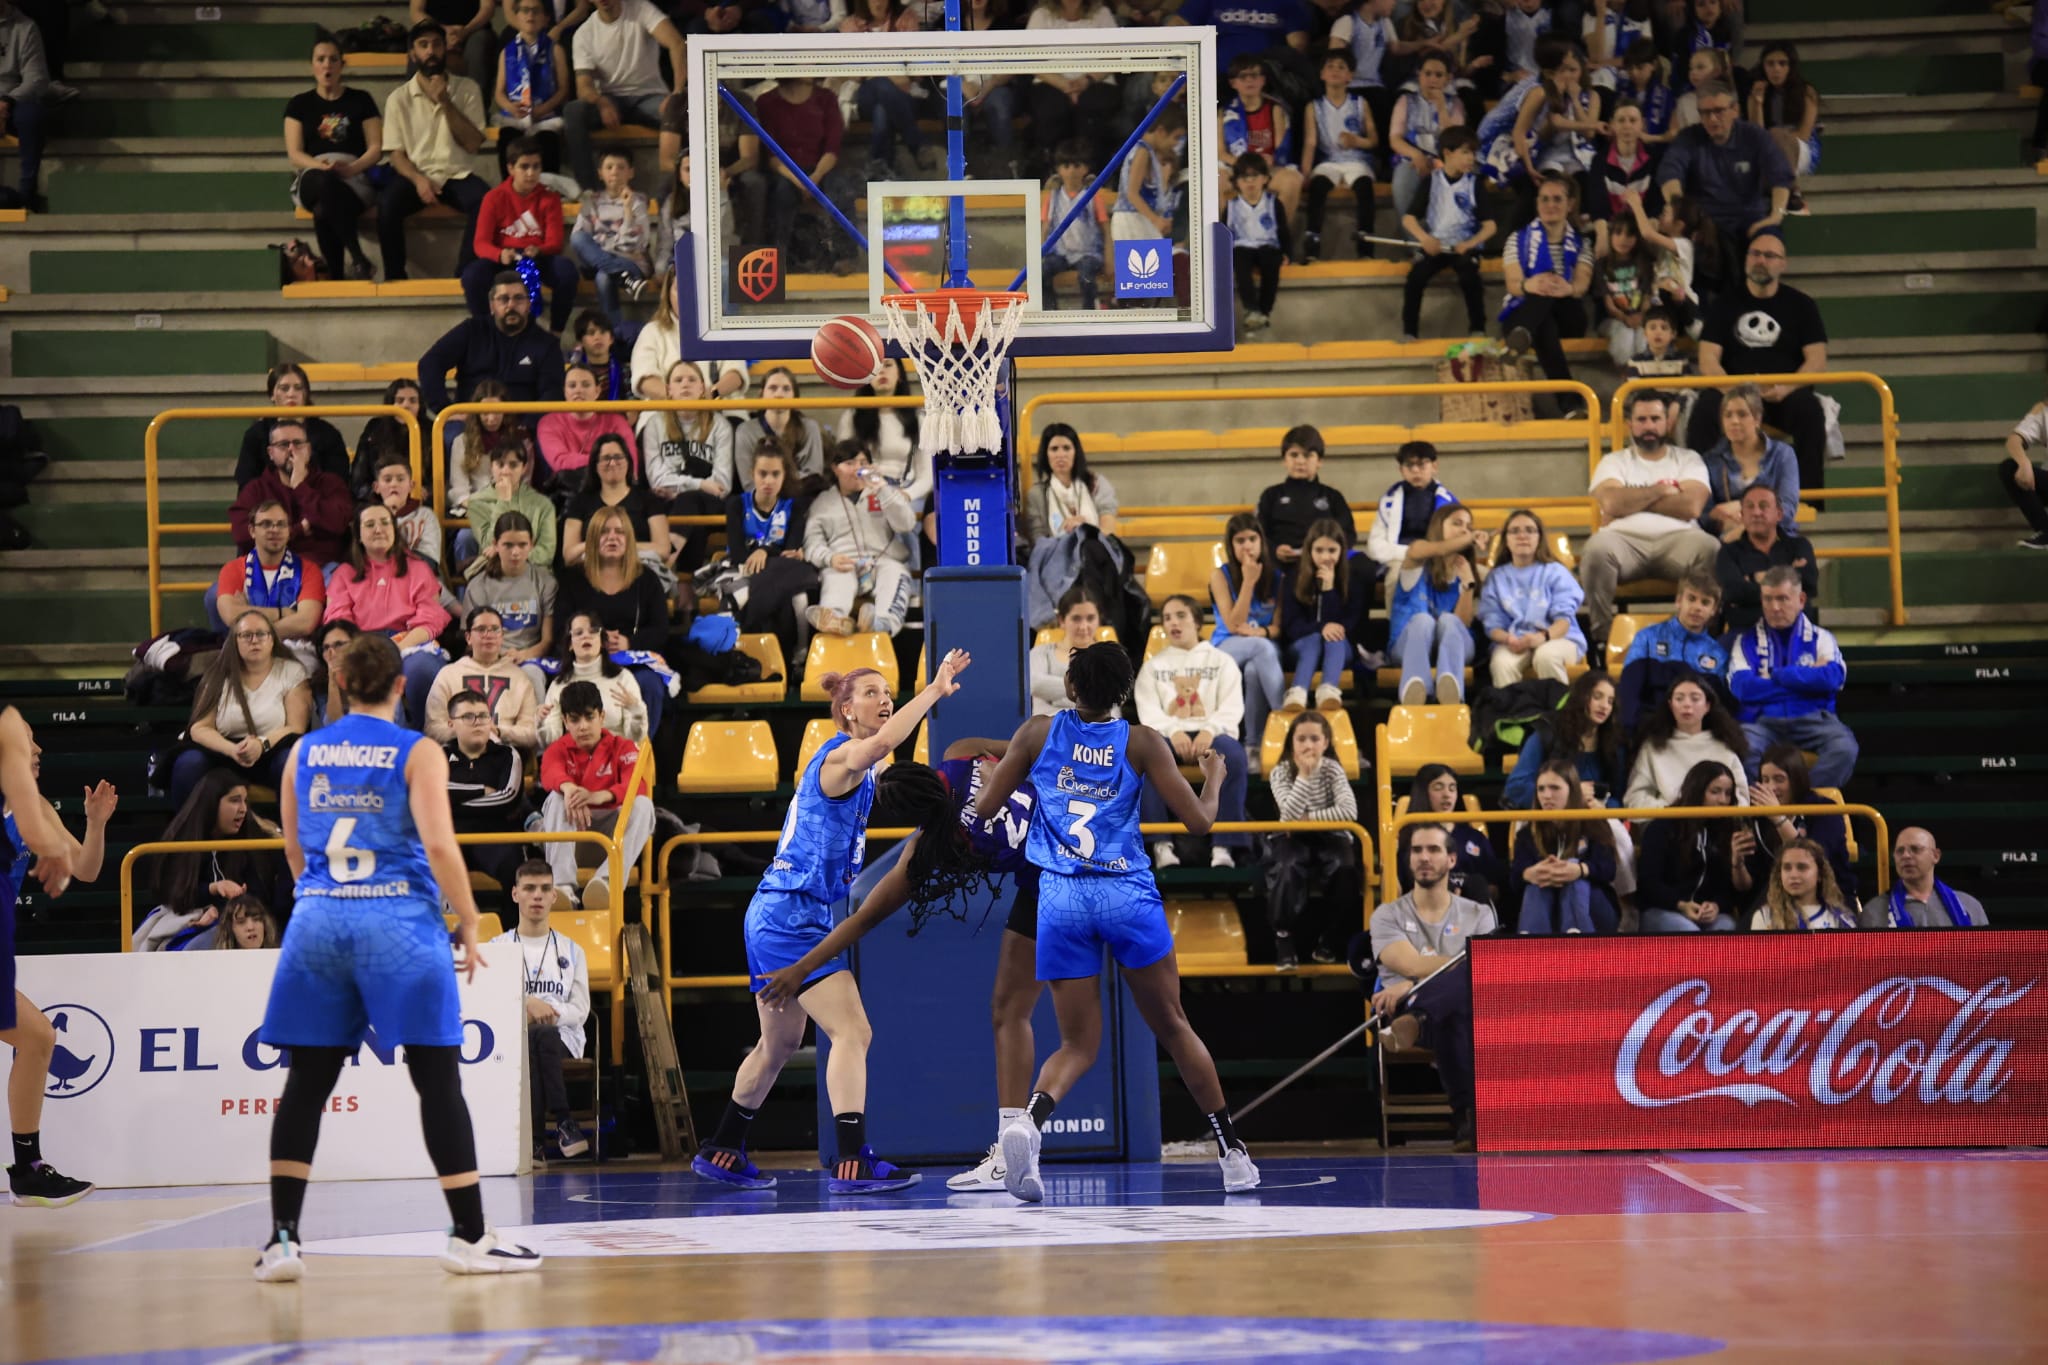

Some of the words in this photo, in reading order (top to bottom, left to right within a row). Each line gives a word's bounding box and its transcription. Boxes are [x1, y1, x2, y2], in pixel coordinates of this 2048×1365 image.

[1220, 9, 1278, 24] adidas
[1120, 282, 1133, 291] LF
[1134, 280, 1168, 290] endesa
[964, 498, 980, 566] MONDO
[1976, 668, 2000, 678] FILA
[2002, 668, 2010, 678] 4
[78, 681, 101, 690] FILA
[104, 681, 110, 690] 5
[79, 712, 86, 720] 4
[307, 740, 399, 769] DOMÍNGUEZ
[1072, 744, 1114, 767] KONÉ
[1982, 758, 2007, 767] FILA
[2009, 757, 2016, 767] 3
[1068, 800, 1097, 859] 3
[325, 817, 376, 883] 6
[2002, 852, 2028, 862] FILA
[2030, 852, 2037, 862] 2
[26, 896, 32, 904] 2
[139, 1027, 218, 1072] EL
[1041, 1118, 1105, 1133] MONDO
